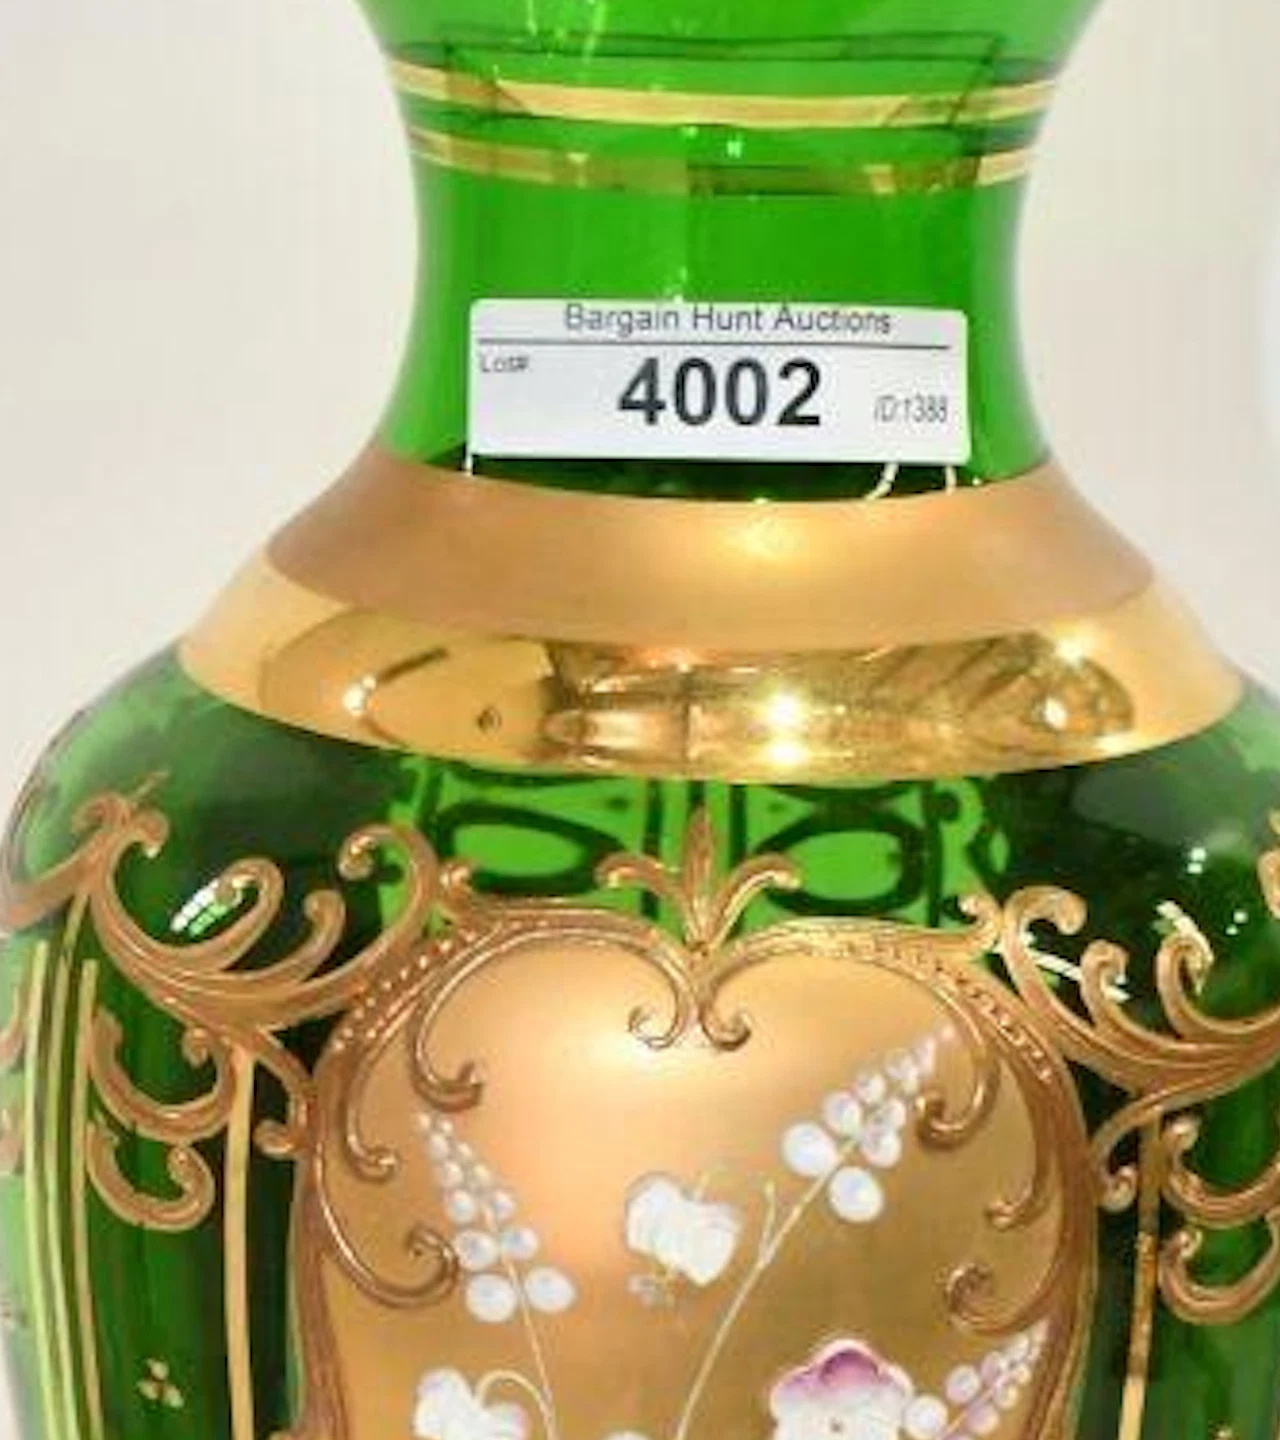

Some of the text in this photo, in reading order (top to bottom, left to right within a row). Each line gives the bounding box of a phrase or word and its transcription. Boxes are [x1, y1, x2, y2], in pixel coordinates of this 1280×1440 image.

[565, 304, 892, 338] Bargain Hunt Auctions
[618, 357, 822, 428] 4002
